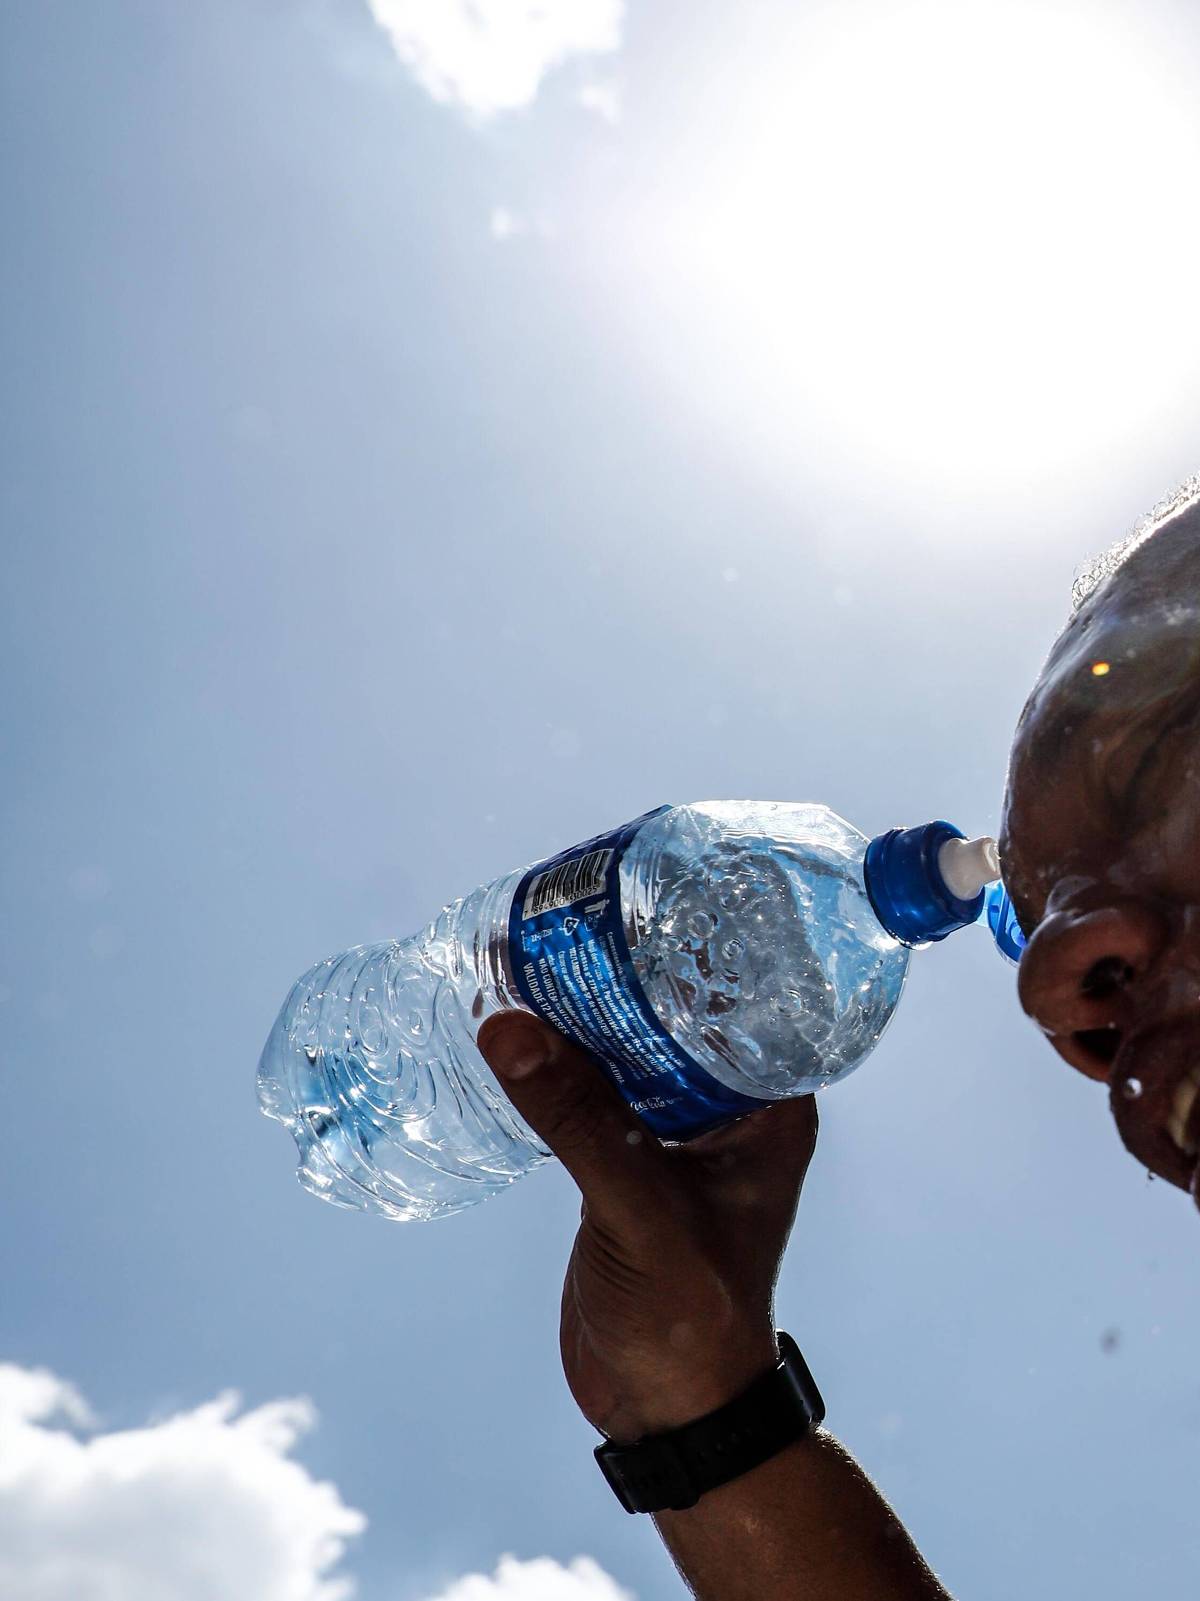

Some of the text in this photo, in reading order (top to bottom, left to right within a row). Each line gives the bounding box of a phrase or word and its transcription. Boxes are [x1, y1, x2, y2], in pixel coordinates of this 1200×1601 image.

[523, 962, 544, 1004] VALIDADE
[541, 1002, 552, 1013] 12
[546, 1011, 570, 1035] MESES
